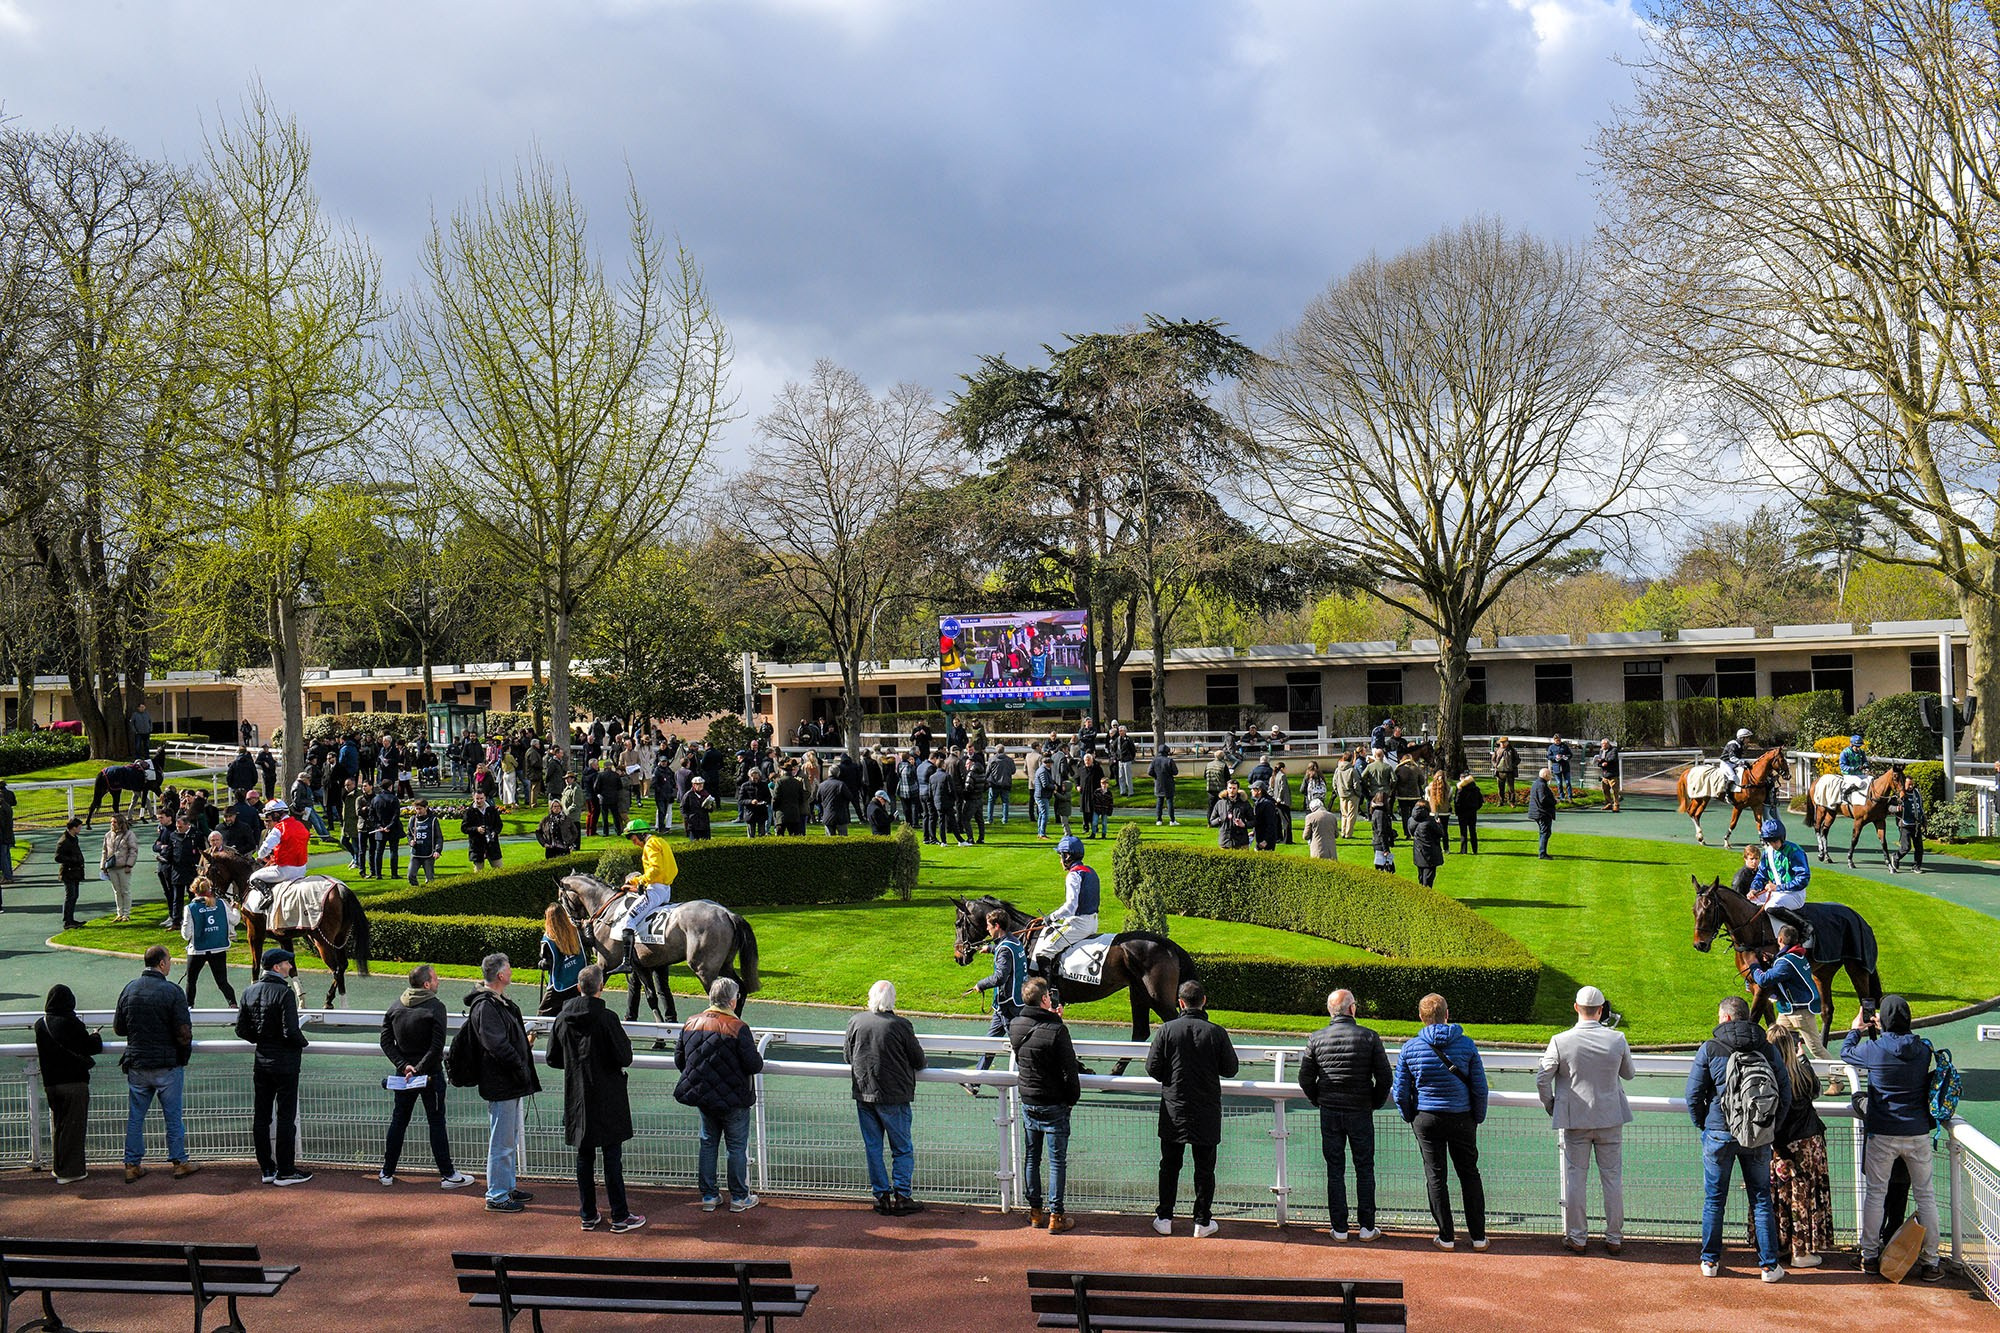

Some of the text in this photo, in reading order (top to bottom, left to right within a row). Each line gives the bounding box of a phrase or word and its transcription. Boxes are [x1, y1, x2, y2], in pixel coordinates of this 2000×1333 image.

[416, 832, 428, 840] 85
[207, 915, 215, 925] 6
[645, 911, 667, 935] 12
[1088, 950, 1104, 977] 3
[1068, 972, 1100, 984] AUTEUIL
